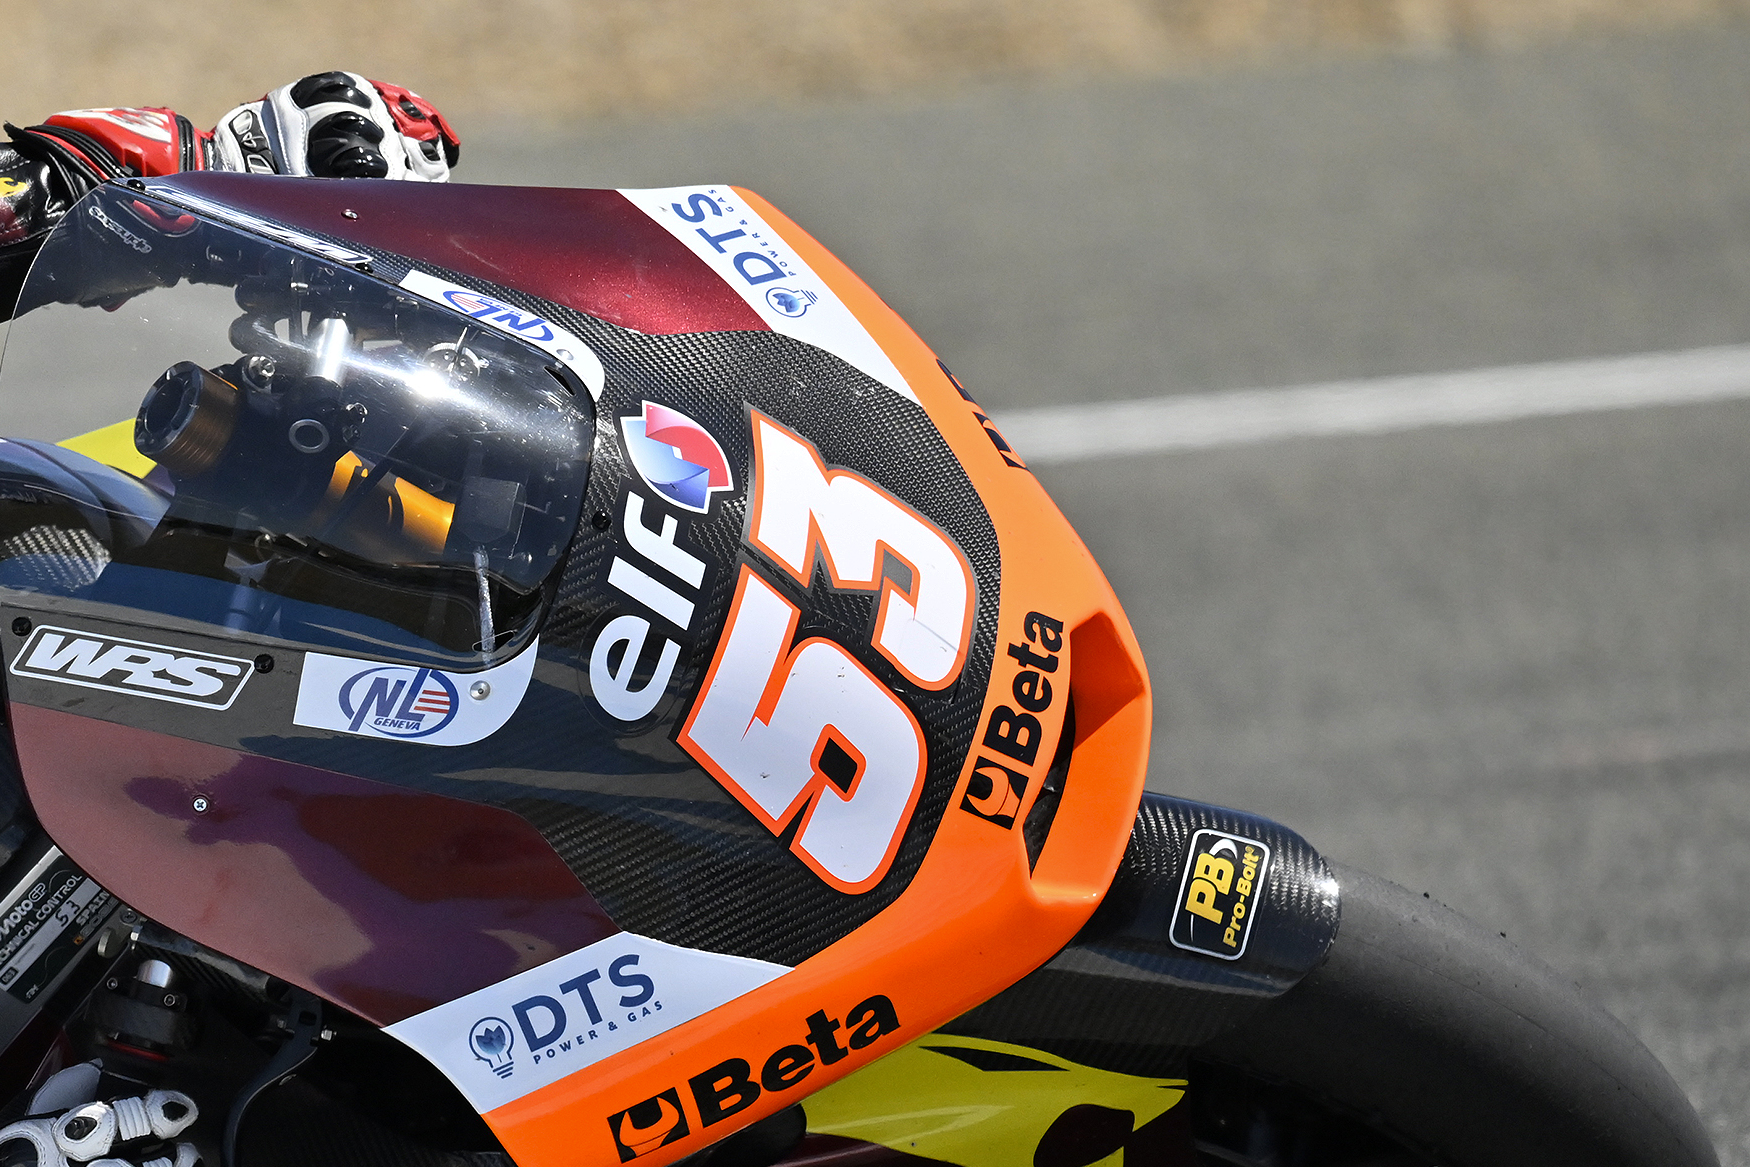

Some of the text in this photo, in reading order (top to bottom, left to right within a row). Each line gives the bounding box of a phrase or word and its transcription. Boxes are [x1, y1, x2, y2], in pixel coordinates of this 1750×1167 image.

[708, 189, 734, 212] GAS
[671, 193, 787, 285] DTS
[752, 232, 797, 277] POWER
[588, 495, 711, 722] elf
[26, 633, 247, 699] WRS
[676, 407, 977, 896] 53
[985, 609, 1065, 765] Beta
[373, 717, 421, 731] GENEVA
[36, 874, 83, 920] CONTROL
[1185, 852, 1235, 925] PB
[512, 953, 656, 1053] DTS
[533, 1000, 664, 1065] POWER & GAS
[687, 993, 902, 1129] Beta
